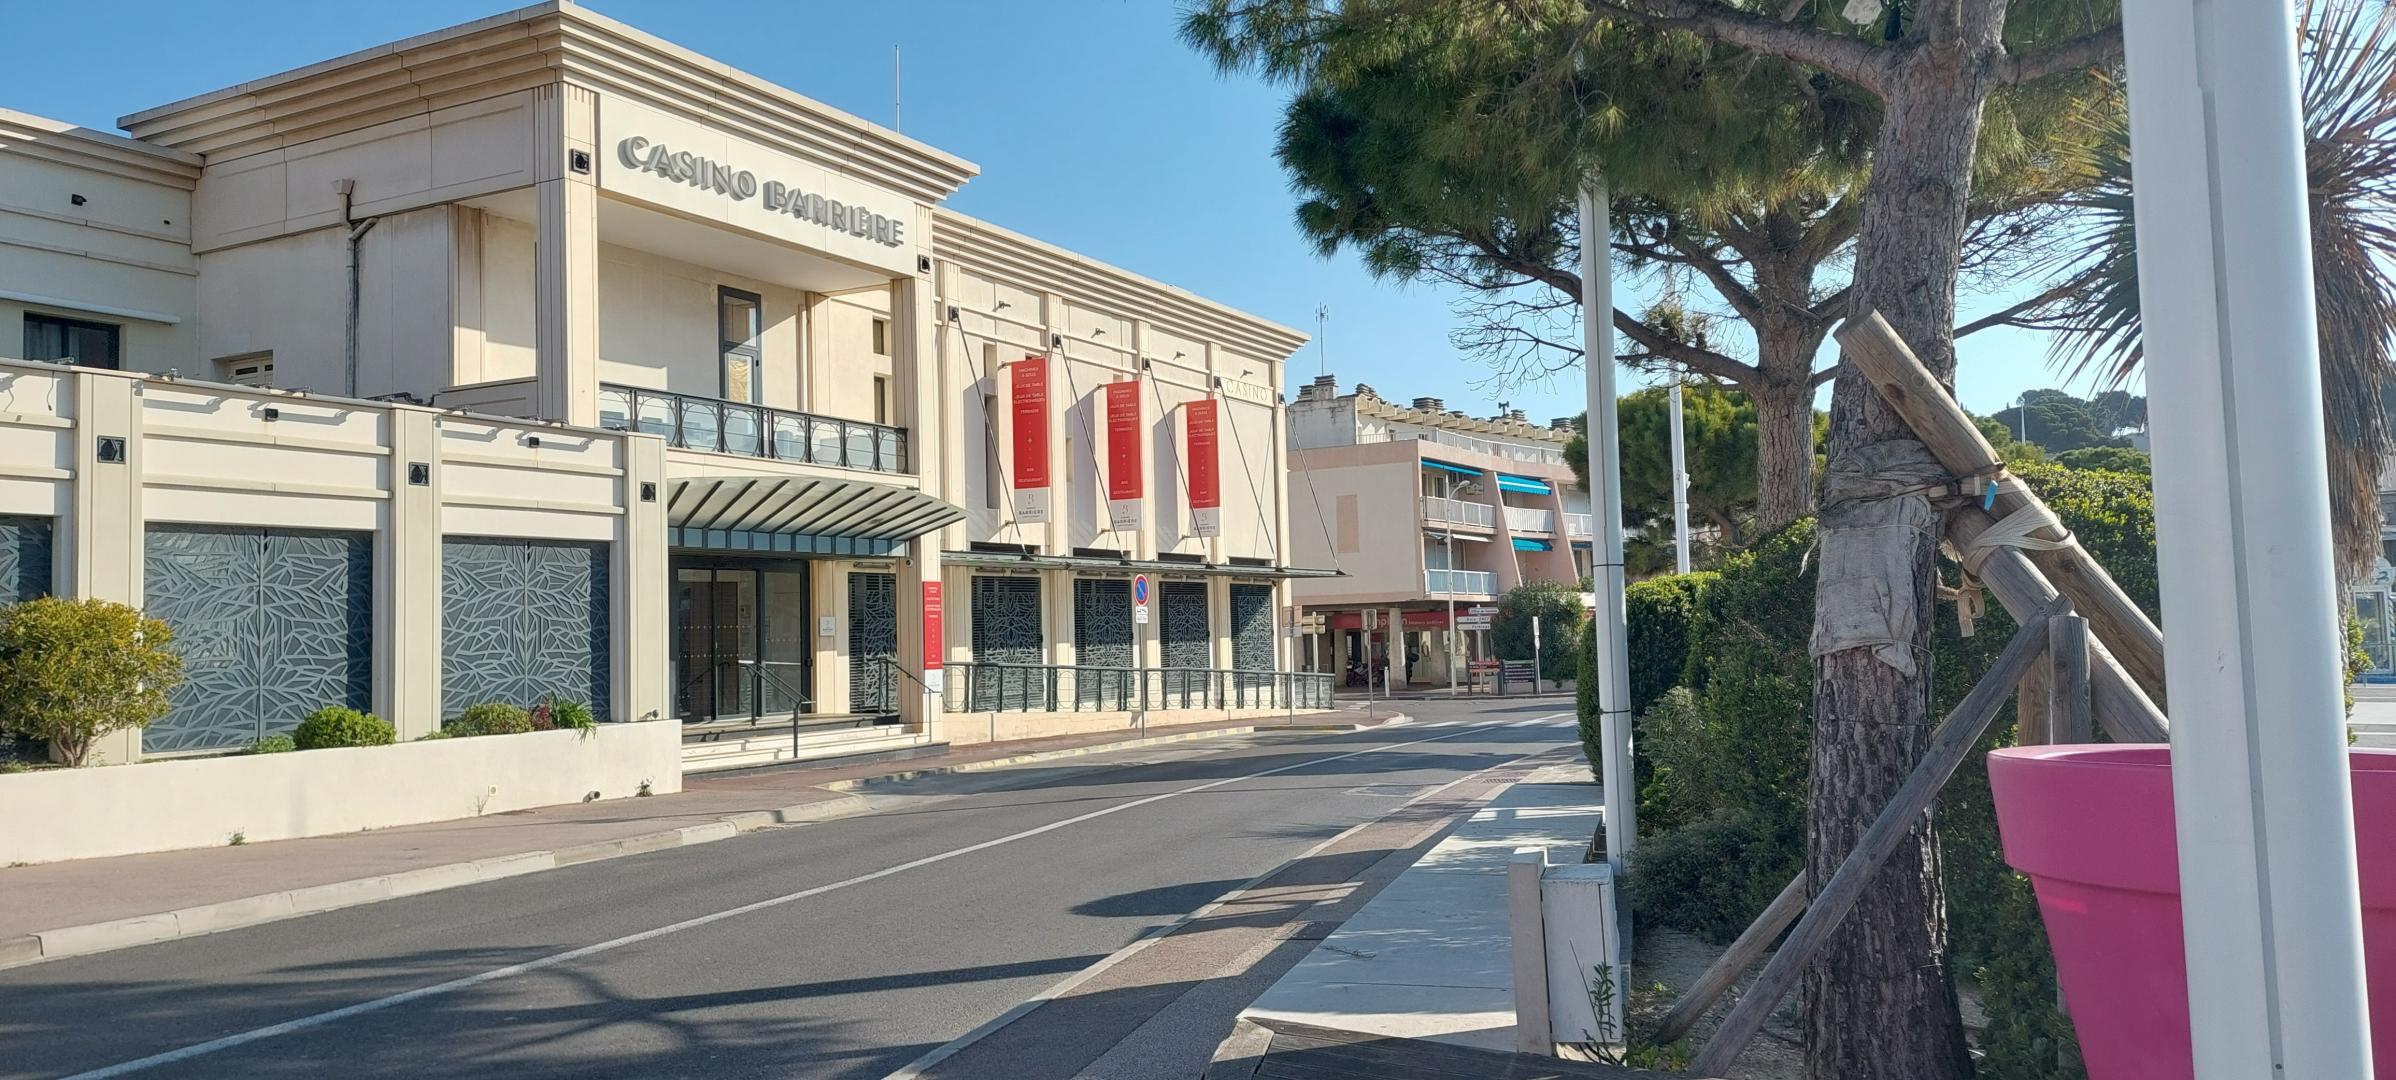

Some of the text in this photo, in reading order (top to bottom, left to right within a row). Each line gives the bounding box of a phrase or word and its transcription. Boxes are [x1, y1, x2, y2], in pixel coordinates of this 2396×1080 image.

[617, 135, 904, 248] CASINO BARRIÈRE
[1226, 380, 1268, 402] CASINO
